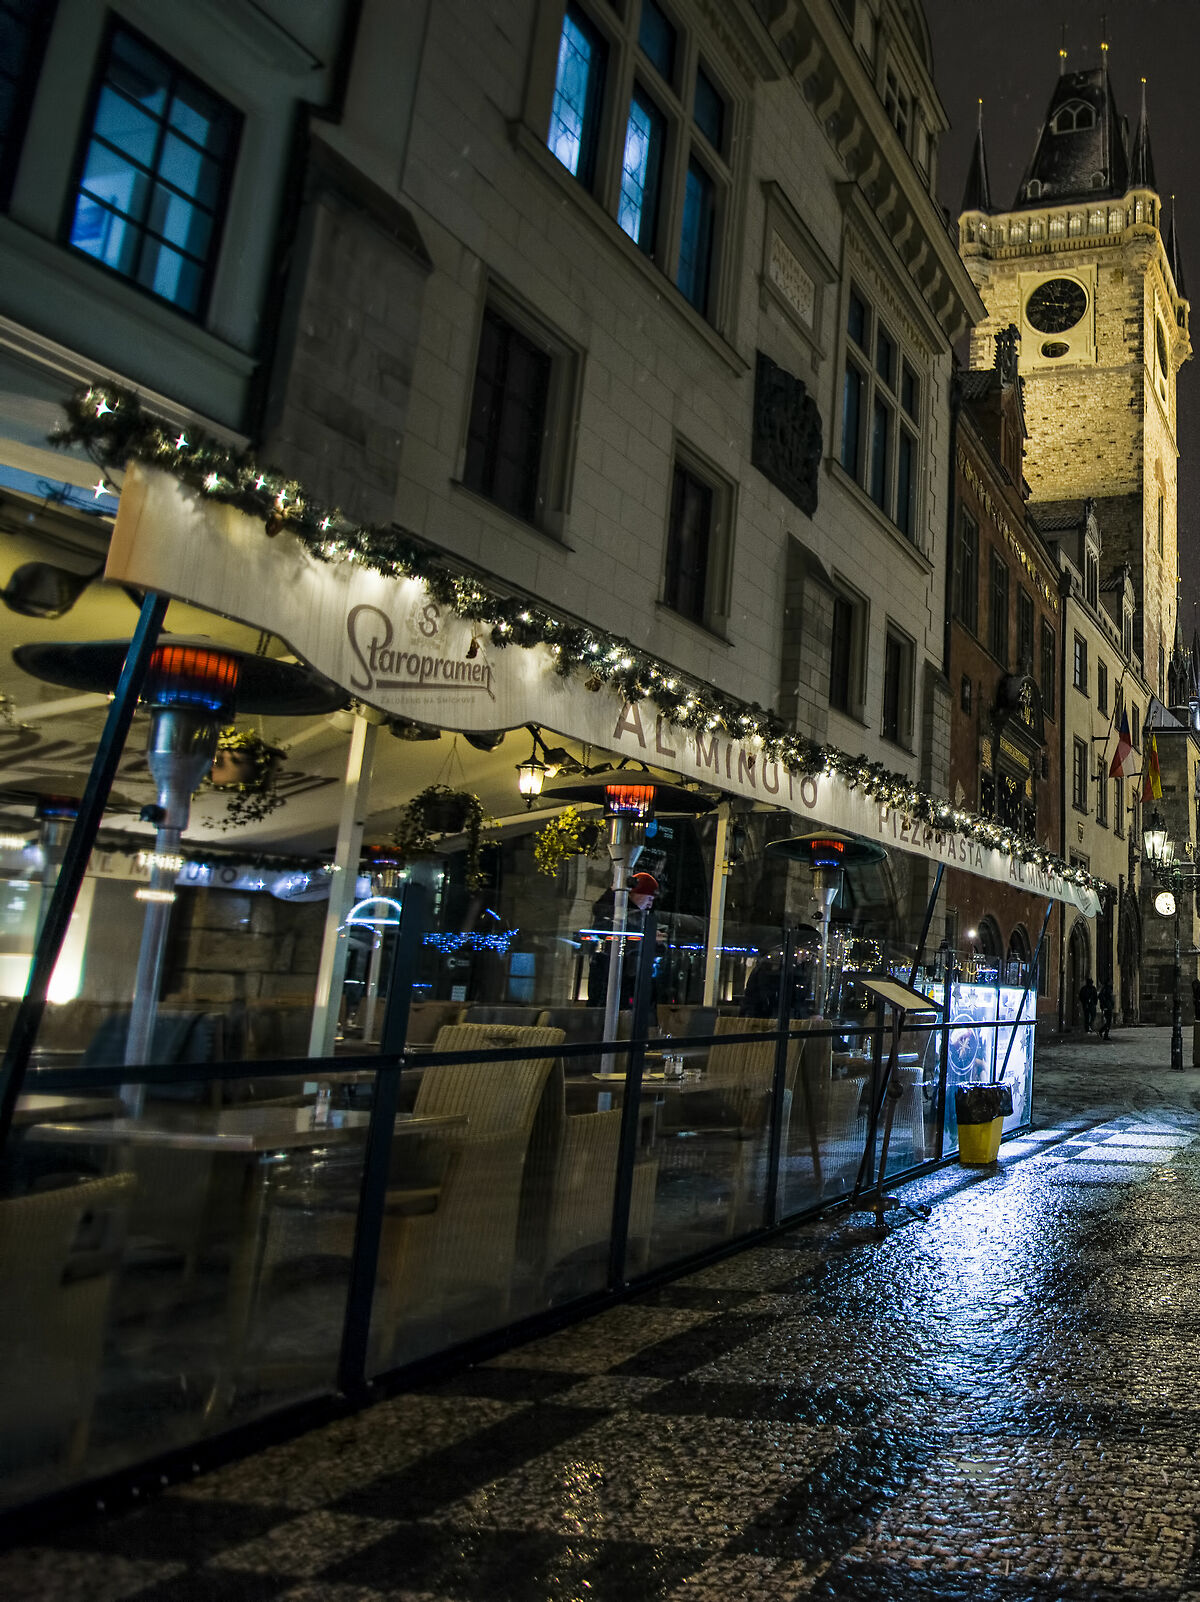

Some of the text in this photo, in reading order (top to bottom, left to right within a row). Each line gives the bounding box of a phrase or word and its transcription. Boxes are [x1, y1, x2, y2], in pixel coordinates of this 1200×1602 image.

[346, 603, 493, 696] Staropramen
[613, 700, 818, 809] AL MINUTO
[878, 804, 984, 869] PIZZA PASTA
[1009, 859, 1025, 883] AL
